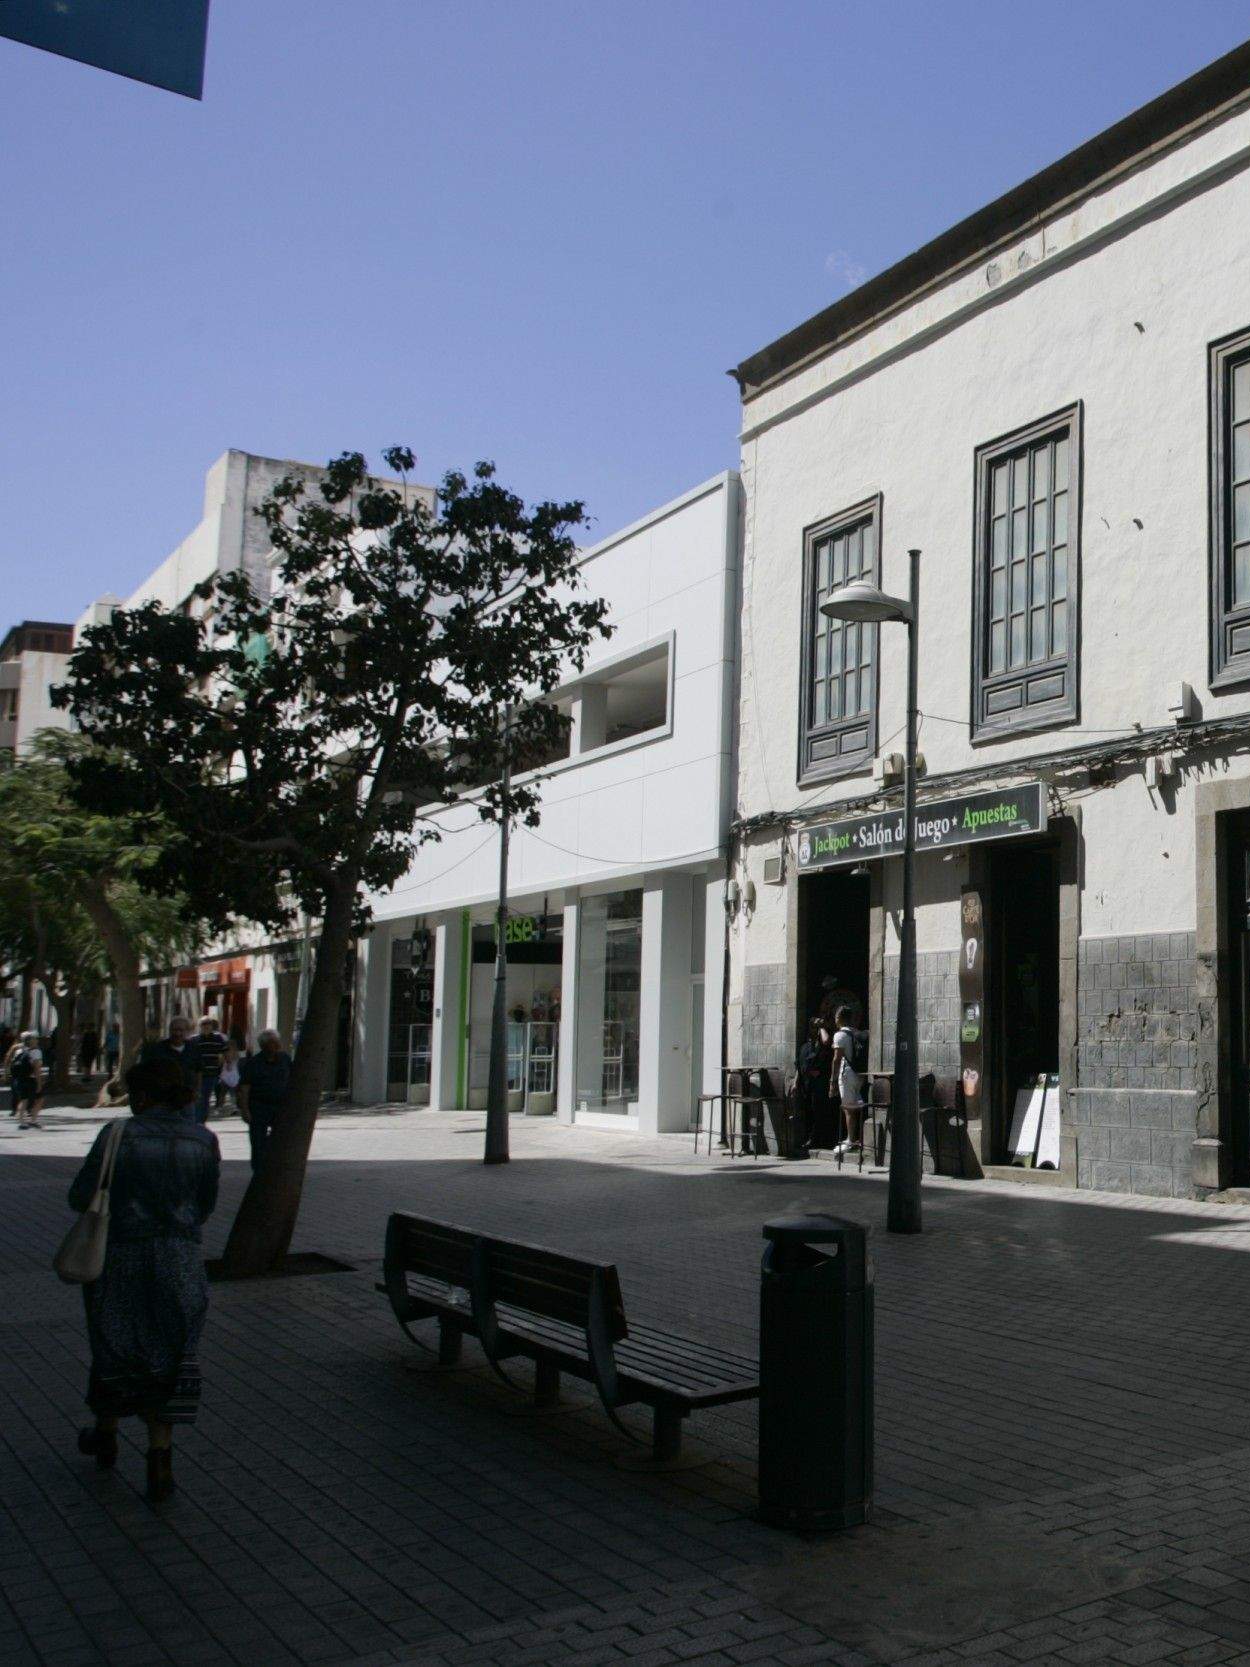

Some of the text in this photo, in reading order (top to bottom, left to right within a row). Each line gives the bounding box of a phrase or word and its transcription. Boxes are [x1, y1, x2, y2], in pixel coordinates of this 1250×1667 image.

[813, 833, 850, 859] Jackpot
[859, 822, 892, 848] Salón
[962, 803, 1018, 833] Apuestas
[495, 911, 534, 944] ase
